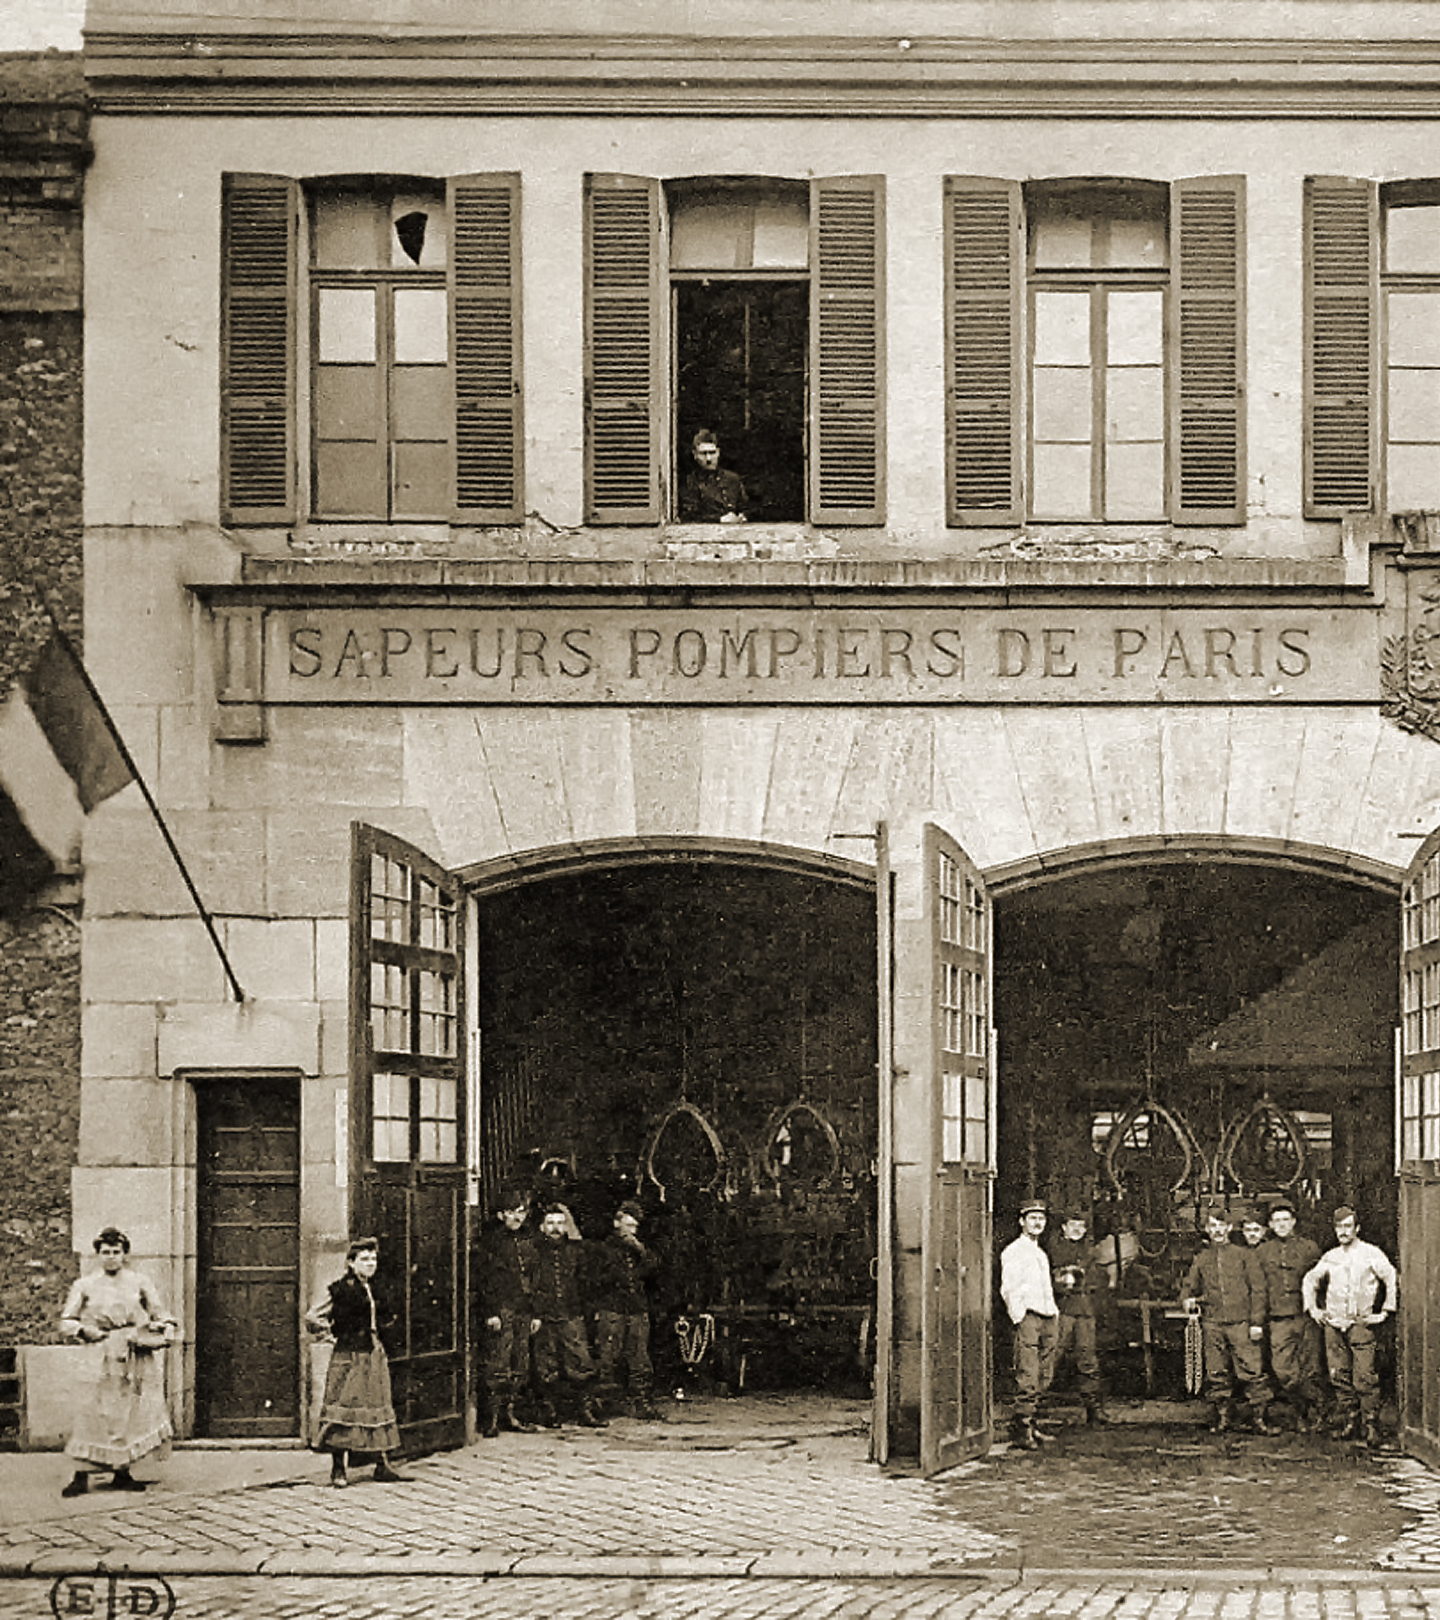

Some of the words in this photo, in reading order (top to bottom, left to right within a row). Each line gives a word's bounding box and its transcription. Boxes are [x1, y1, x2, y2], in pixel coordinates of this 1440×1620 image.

[287, 627, 594, 679] SAPEURS
[627, 627, 961, 679] POMPIERS
[996, 627, 1079, 679] DE
[1111, 627, 1313, 679] PARIS
